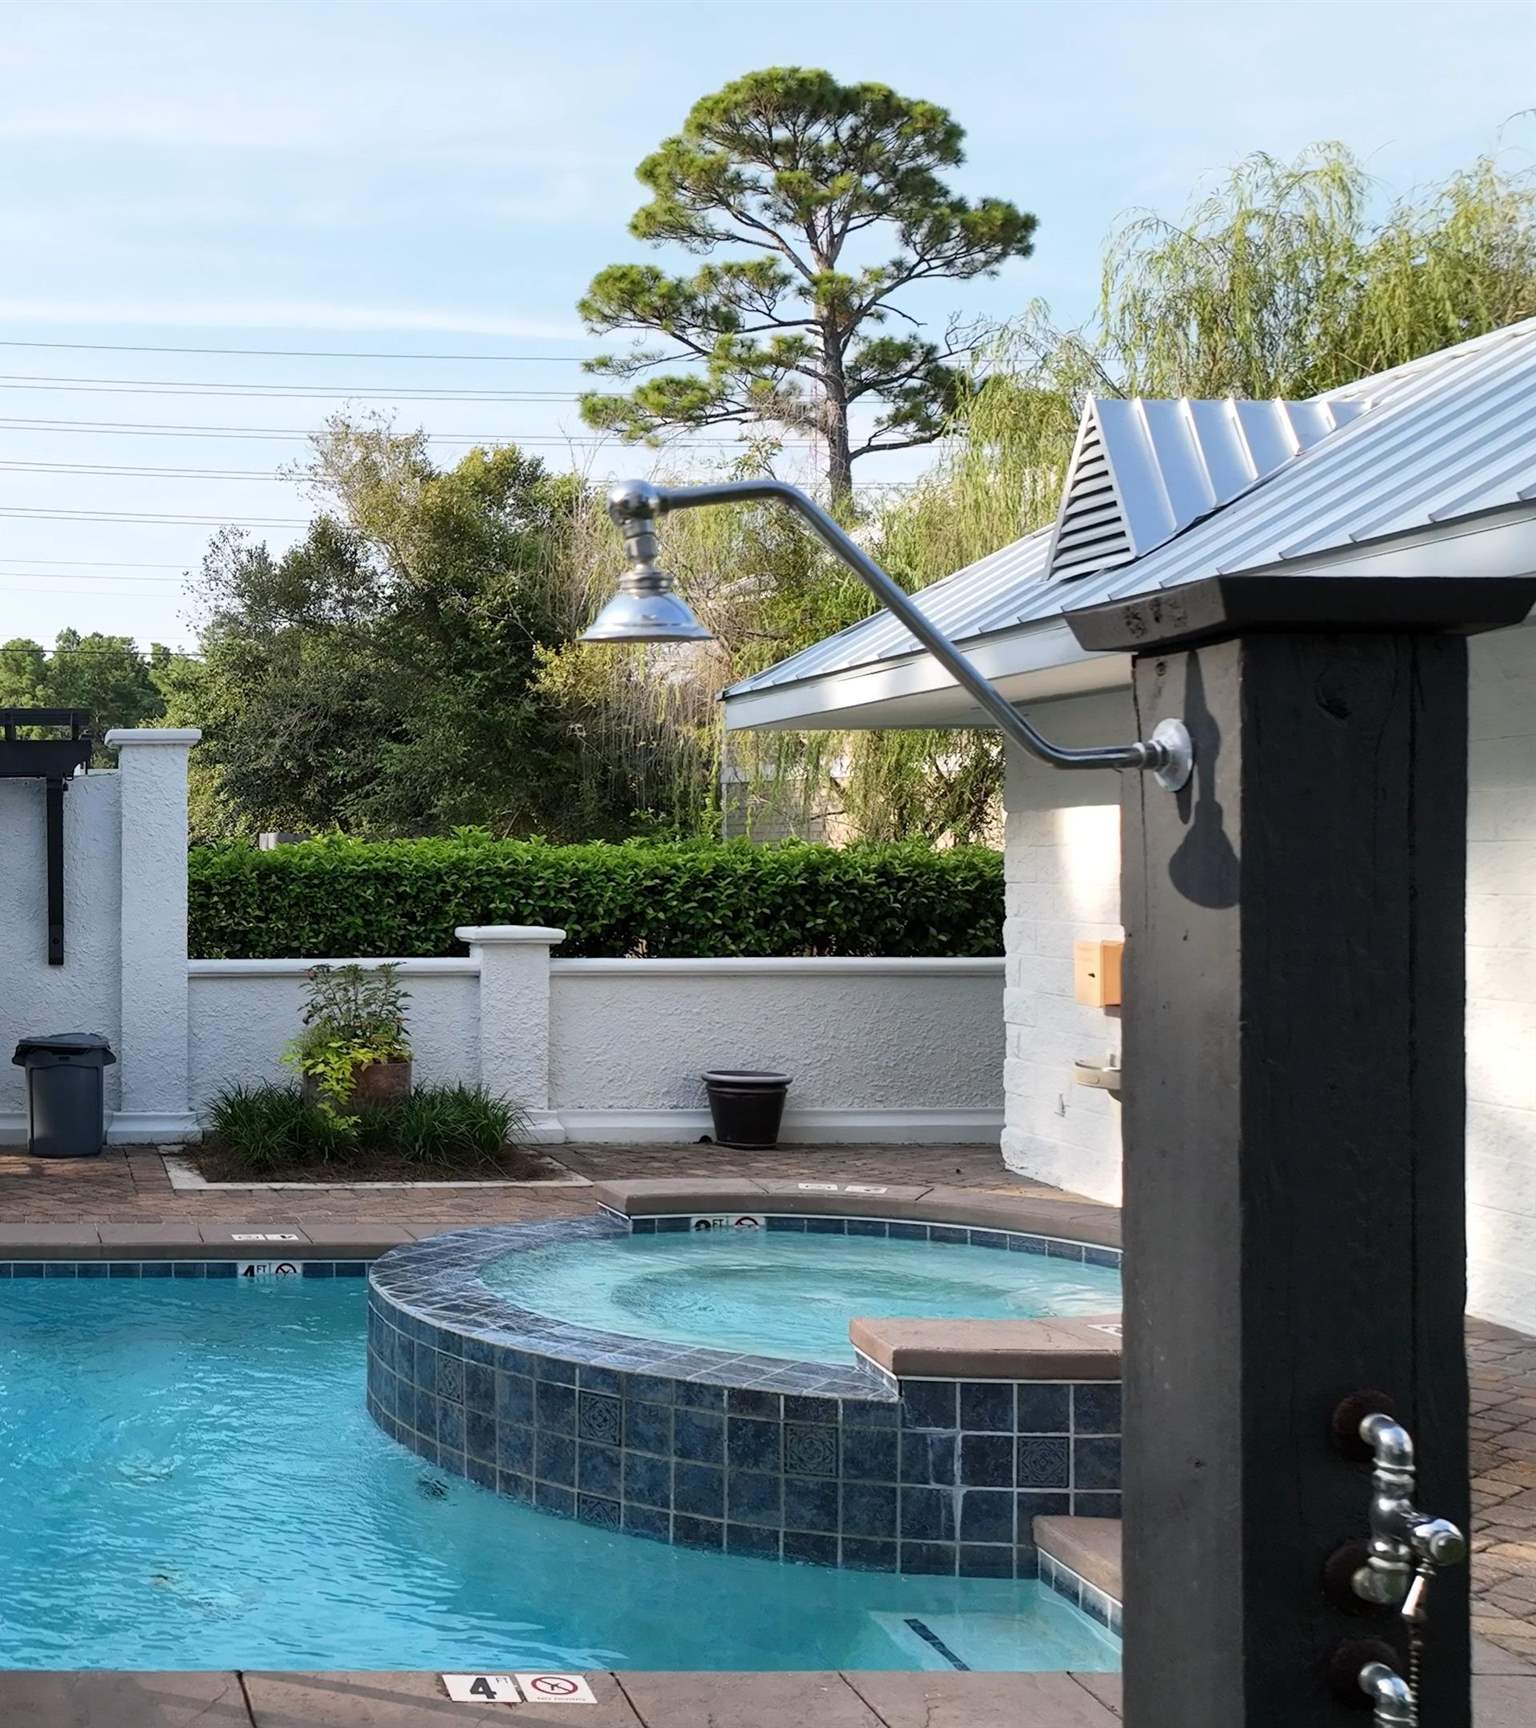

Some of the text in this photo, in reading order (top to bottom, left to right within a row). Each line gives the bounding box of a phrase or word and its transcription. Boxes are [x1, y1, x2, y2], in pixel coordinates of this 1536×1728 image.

[243, 1265, 267, 1277] 4 FT
[469, 1677, 497, 1699] 4
